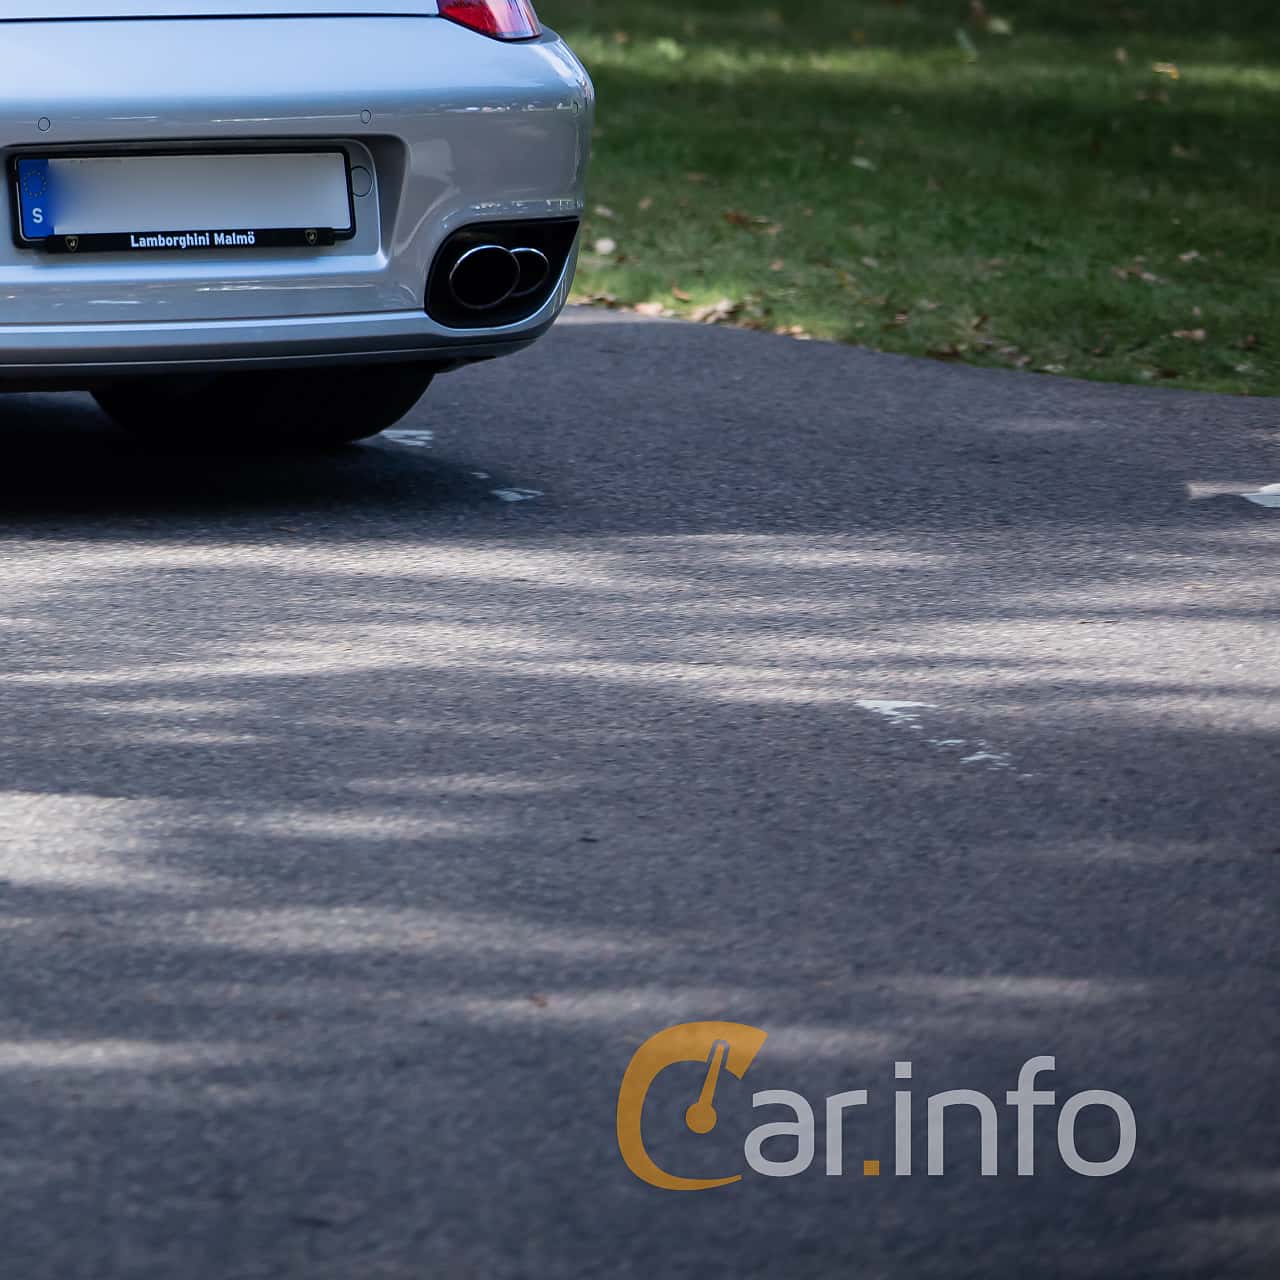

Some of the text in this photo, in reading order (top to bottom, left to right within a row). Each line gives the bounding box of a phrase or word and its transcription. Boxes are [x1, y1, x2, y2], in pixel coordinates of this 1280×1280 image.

[32, 207, 44, 224] S
[130, 231, 256, 249] Lamborghini Malmö
